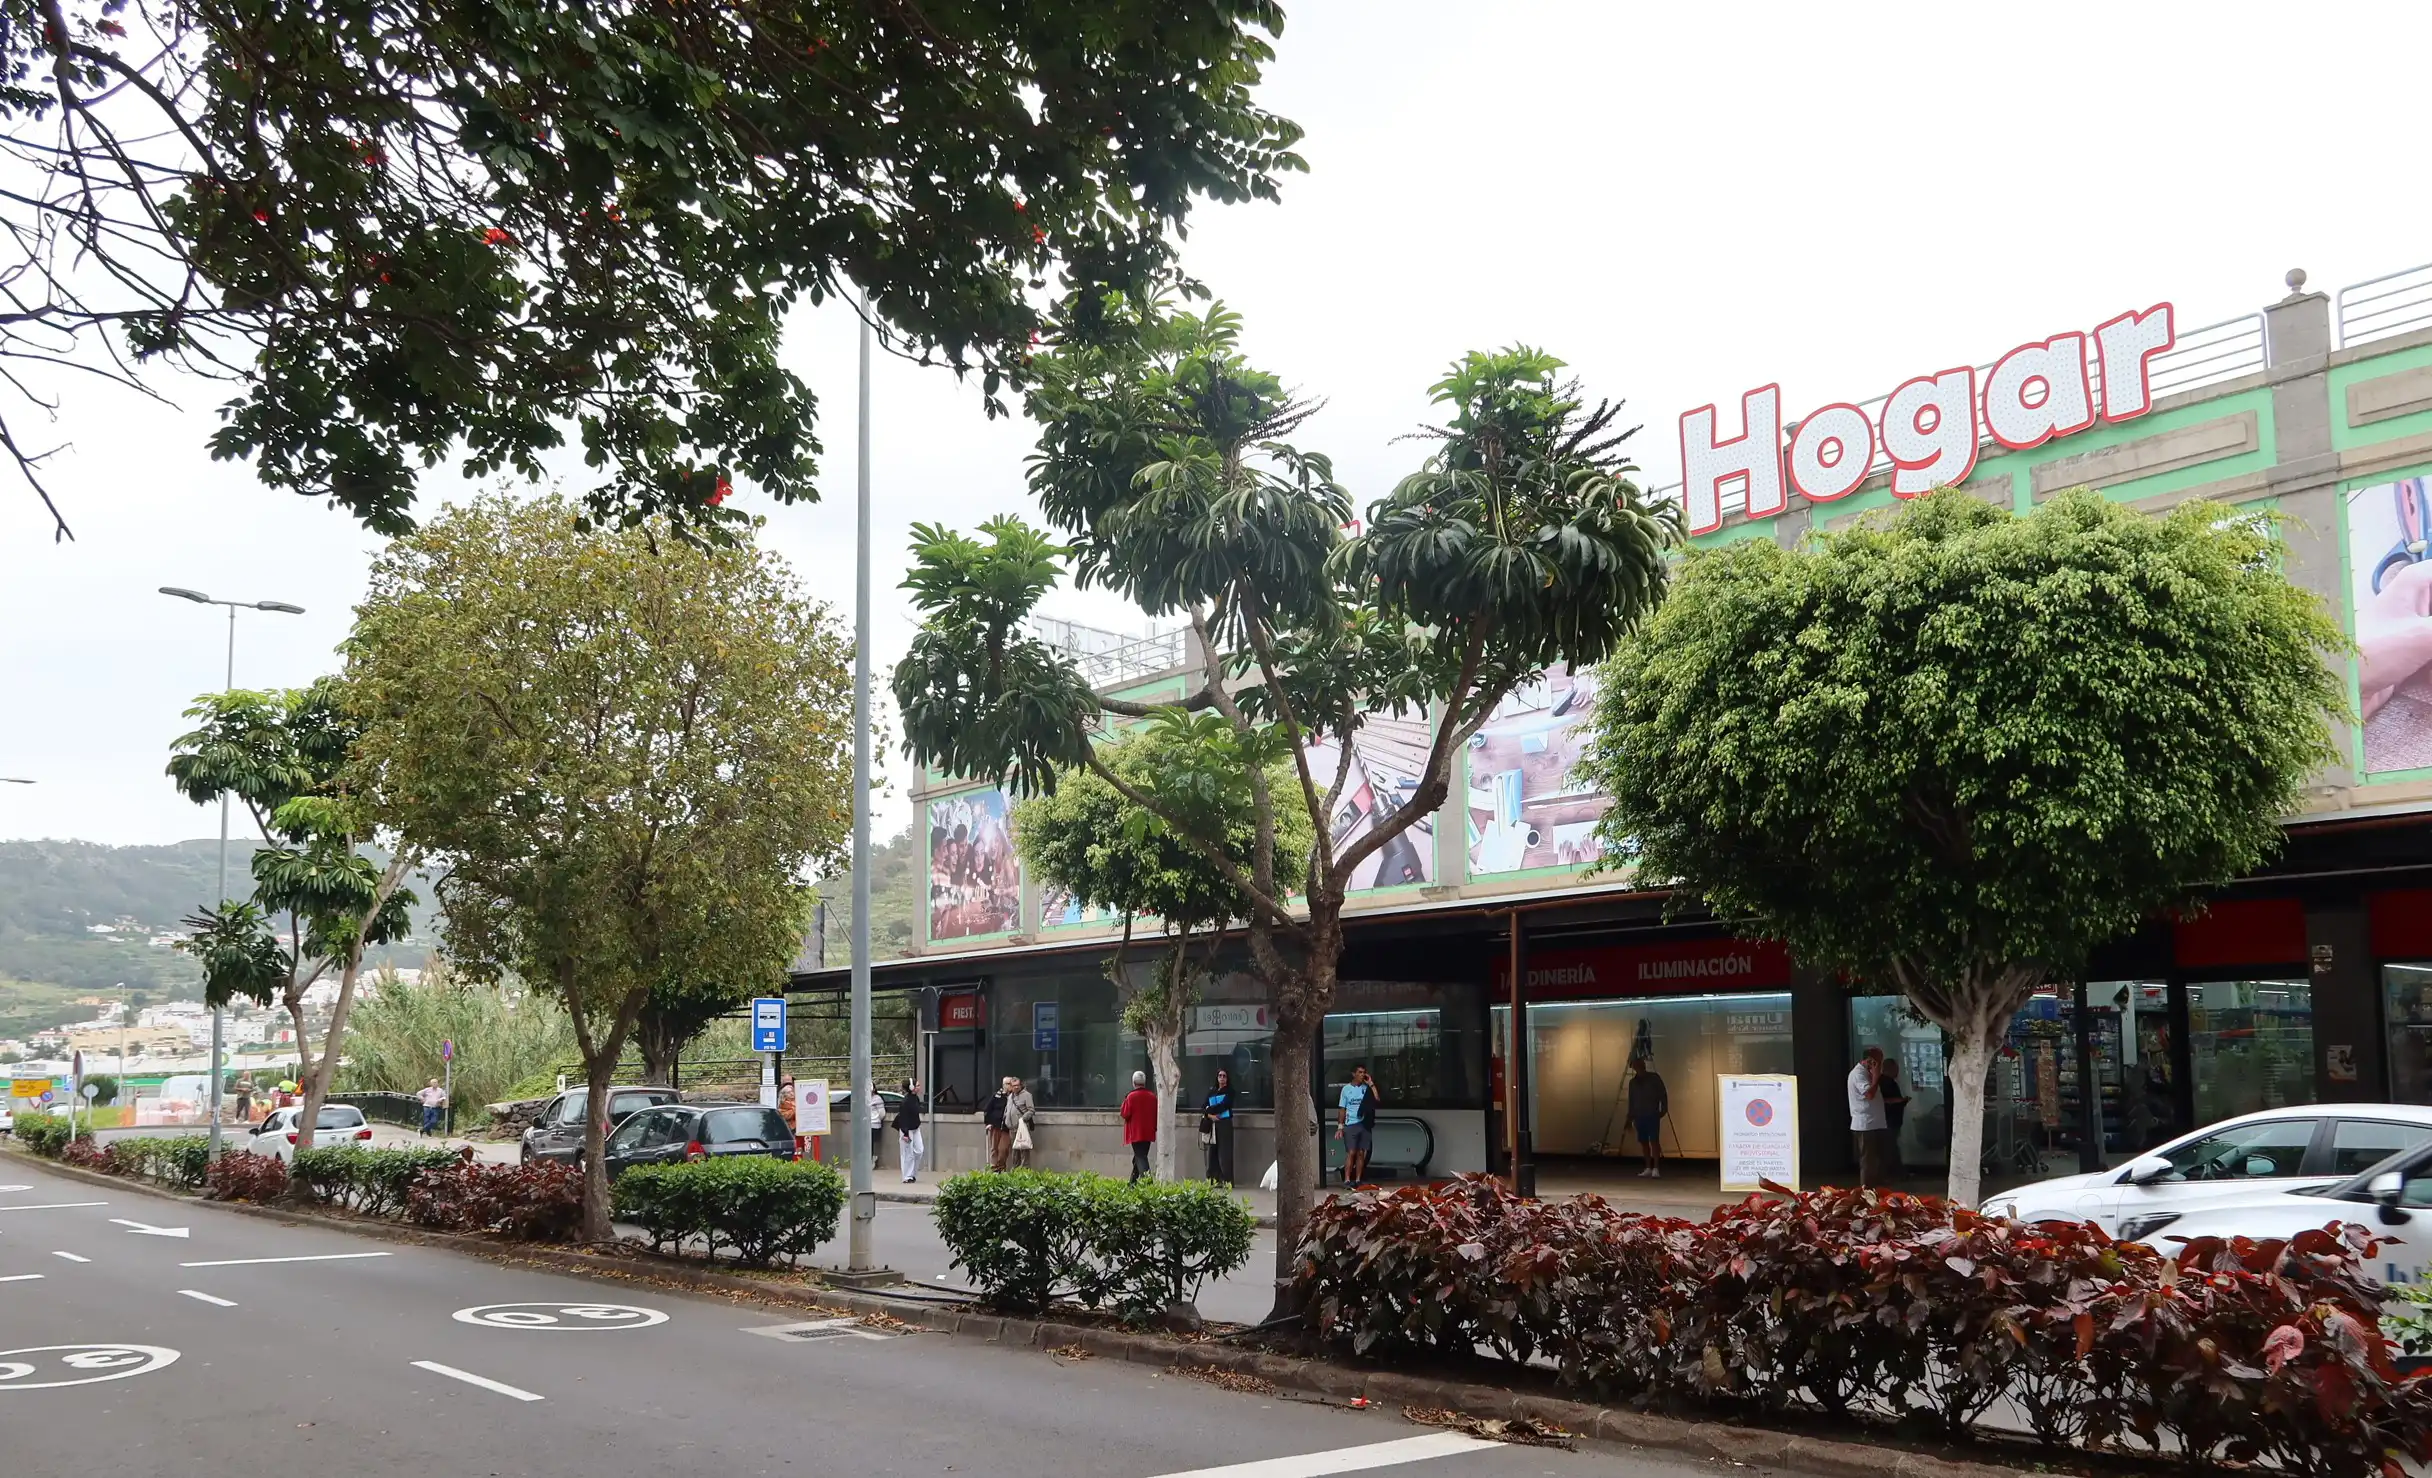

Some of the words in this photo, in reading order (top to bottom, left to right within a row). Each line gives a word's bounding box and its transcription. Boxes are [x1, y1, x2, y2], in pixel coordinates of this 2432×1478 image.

[1680, 301, 2175, 537] Hogar
[1638, 951, 1752, 981] ILUMINACIÓN
[484, 1307, 640, 1325] 30
